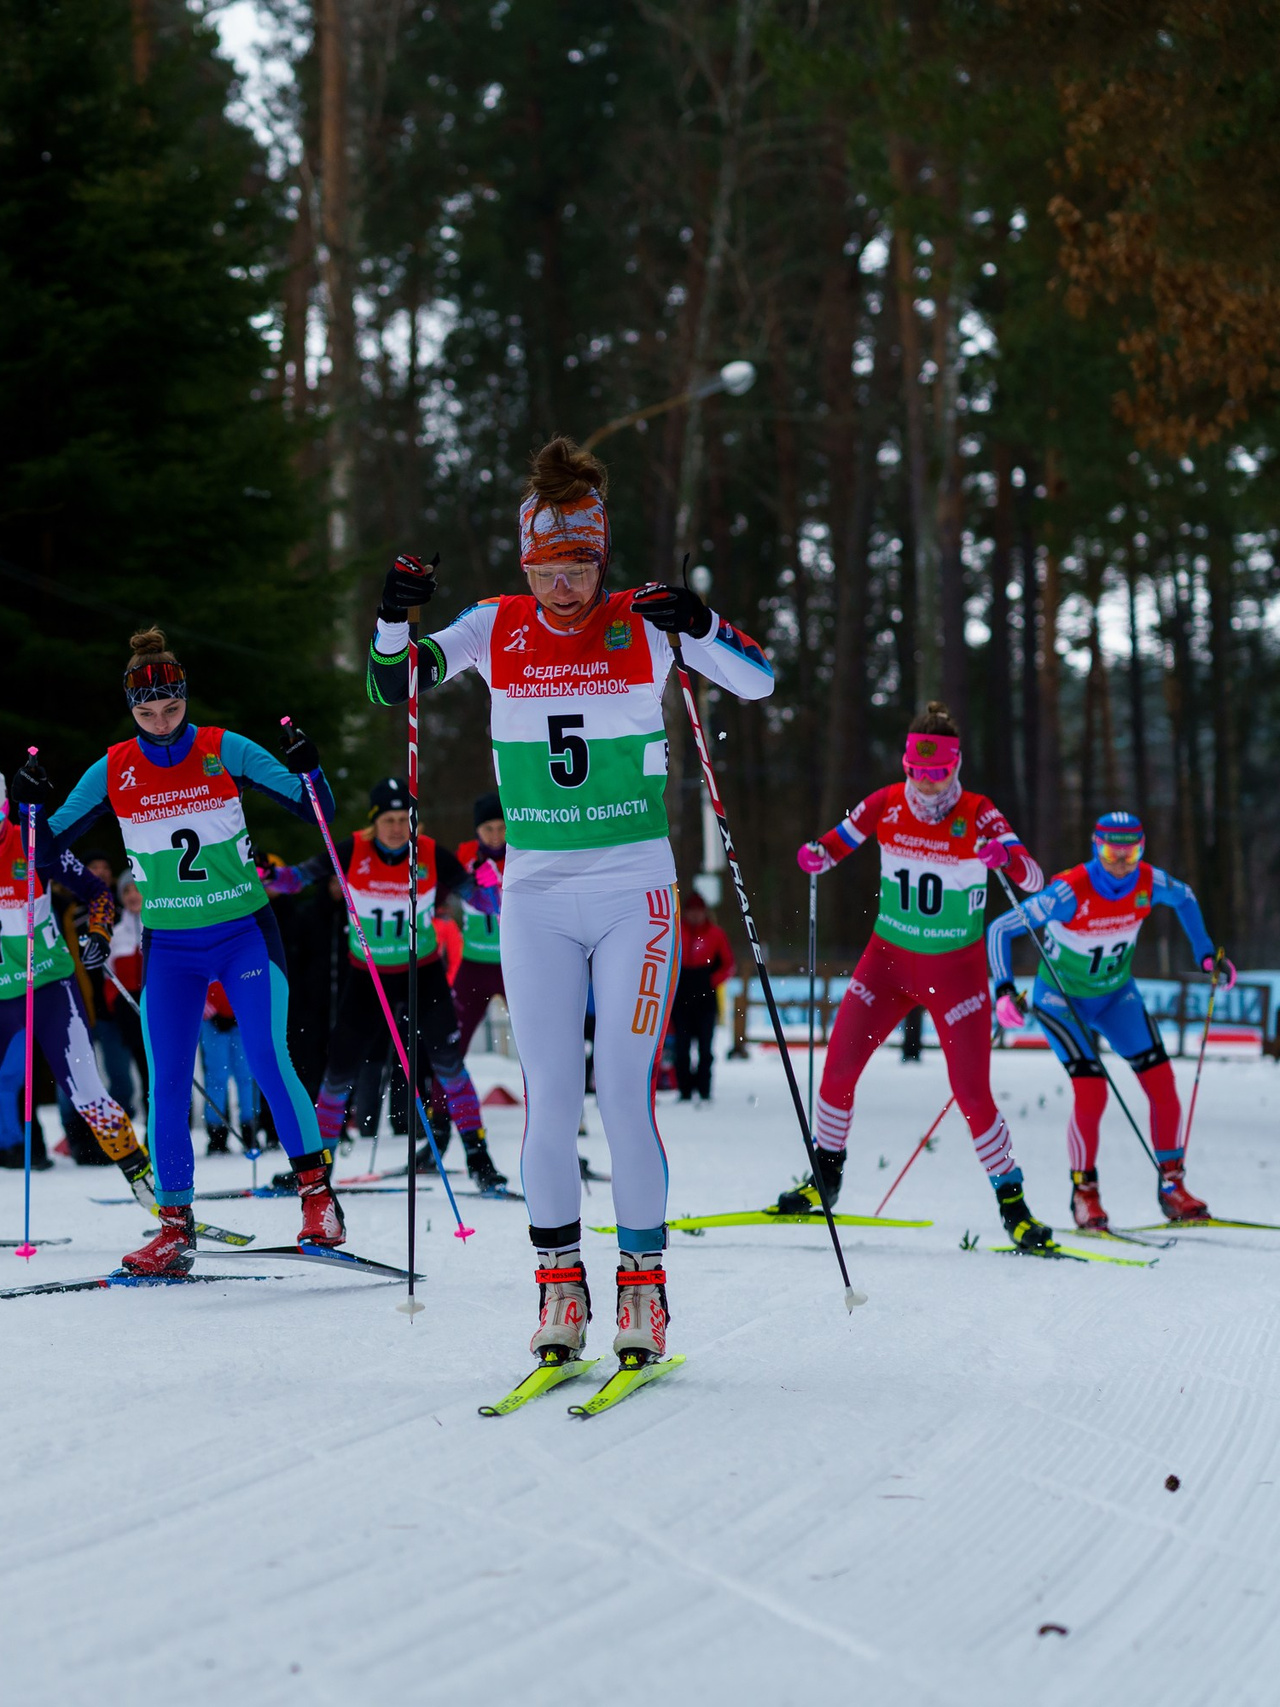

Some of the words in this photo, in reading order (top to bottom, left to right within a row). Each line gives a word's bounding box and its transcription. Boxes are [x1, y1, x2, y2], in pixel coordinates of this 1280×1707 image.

[523, 661, 609, 680] ФЕДЕРАЦИЯ
[506, 681, 574, 698] ЛЫЖНЫХ
[578, 678, 629, 696] ГОНОК
[547, 714, 590, 789] 5
[140, 784, 210, 806] ФЕДЕРАЦИЯ
[131, 804, 185, 824] ЛЫЖНЫХ
[187, 797, 225, 814] ГОНОК
[506, 805, 581, 823] КАЛУЖСКОЙ
[586, 799, 648, 820] ОБЛАСТИ
[893, 833, 950, 852] ФЕДЕРАЦИЯ
[171, 828, 208, 882] 2
[207, 882, 252, 904] ОБЛАСТИ
[894, 868, 943, 917] 10
[371, 907, 405, 938] 11
[923, 927, 968, 938] ОБЛАСТИ
[631, 889, 671, 1036] SPINE
[240, 968, 263, 980] RAY
[552, 1271, 582, 1279] ROSSIGNO
